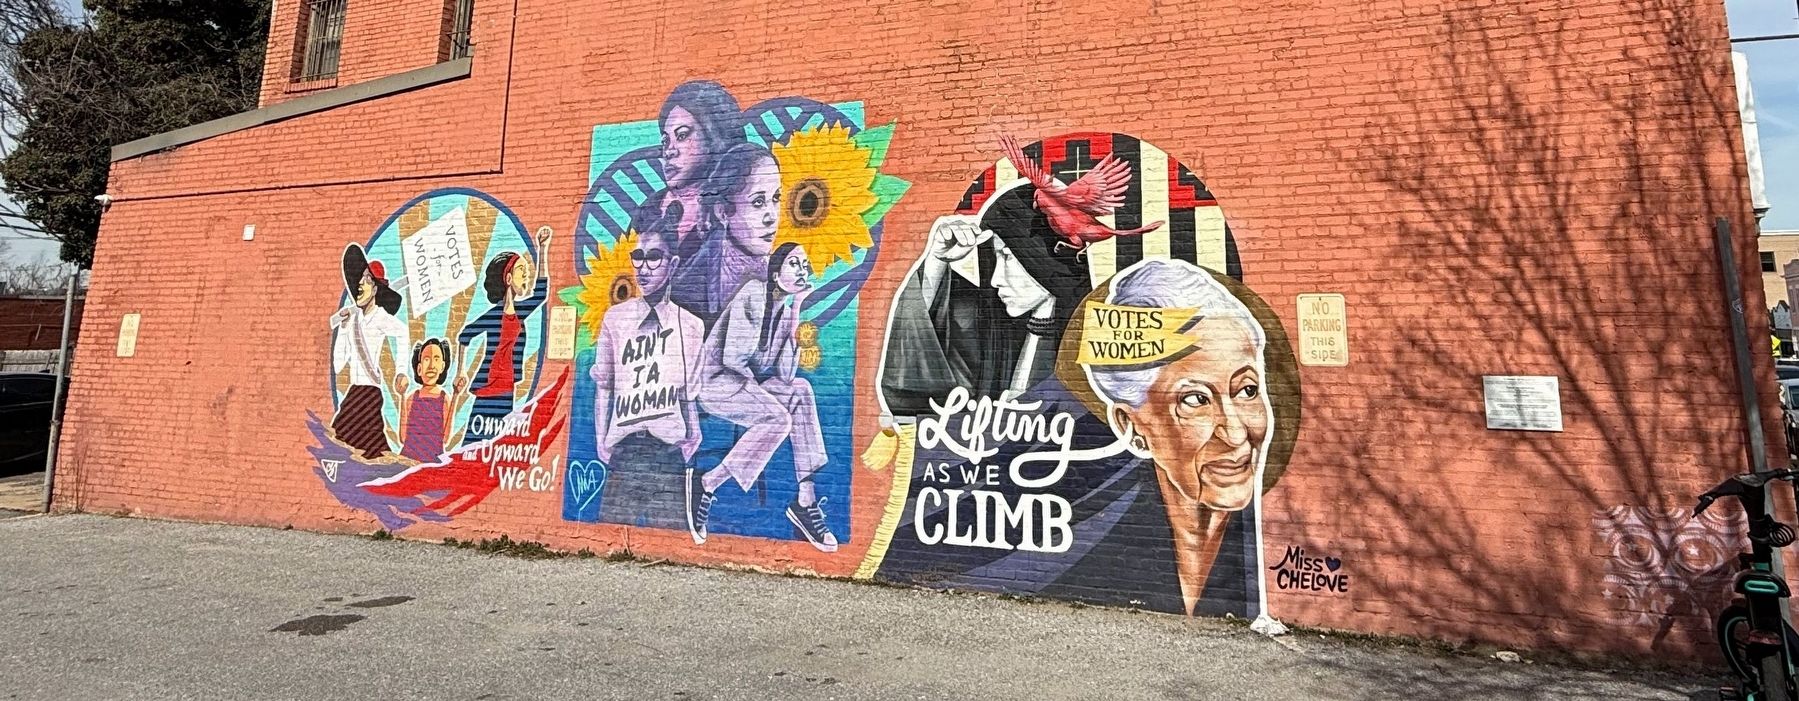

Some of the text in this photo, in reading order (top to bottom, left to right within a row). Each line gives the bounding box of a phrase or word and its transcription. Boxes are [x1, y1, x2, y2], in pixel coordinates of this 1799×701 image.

[430, 254, 447, 267] for
[445, 225, 464, 279] VOTES
[414, 237, 434, 303] WOMEN
[1093, 308, 1163, 330] VOTES
[1311, 302, 1330, 315] NO
[1113, 330, 1144, 341] FOR
[1302, 318, 1342, 332] PARKING
[621, 325, 674, 366] AIN'T
[1088, 339, 1165, 360] WOMEN
[1310, 336, 1336, 346] THIS
[1311, 349, 1337, 360] SIDE
[632, 361, 660, 389] I A
[615, 385, 679, 419] WOMAN
[471, 409, 534, 437] Onward
[918, 386, 1095, 488] Lifting
[461, 429, 546, 477] and Upward
[496, 454, 560, 492] We Go!
[923, 462, 1000, 486] AS WE
[914, 486, 1074, 554] CLIMB
[1269, 545, 1324, 573] Miss
